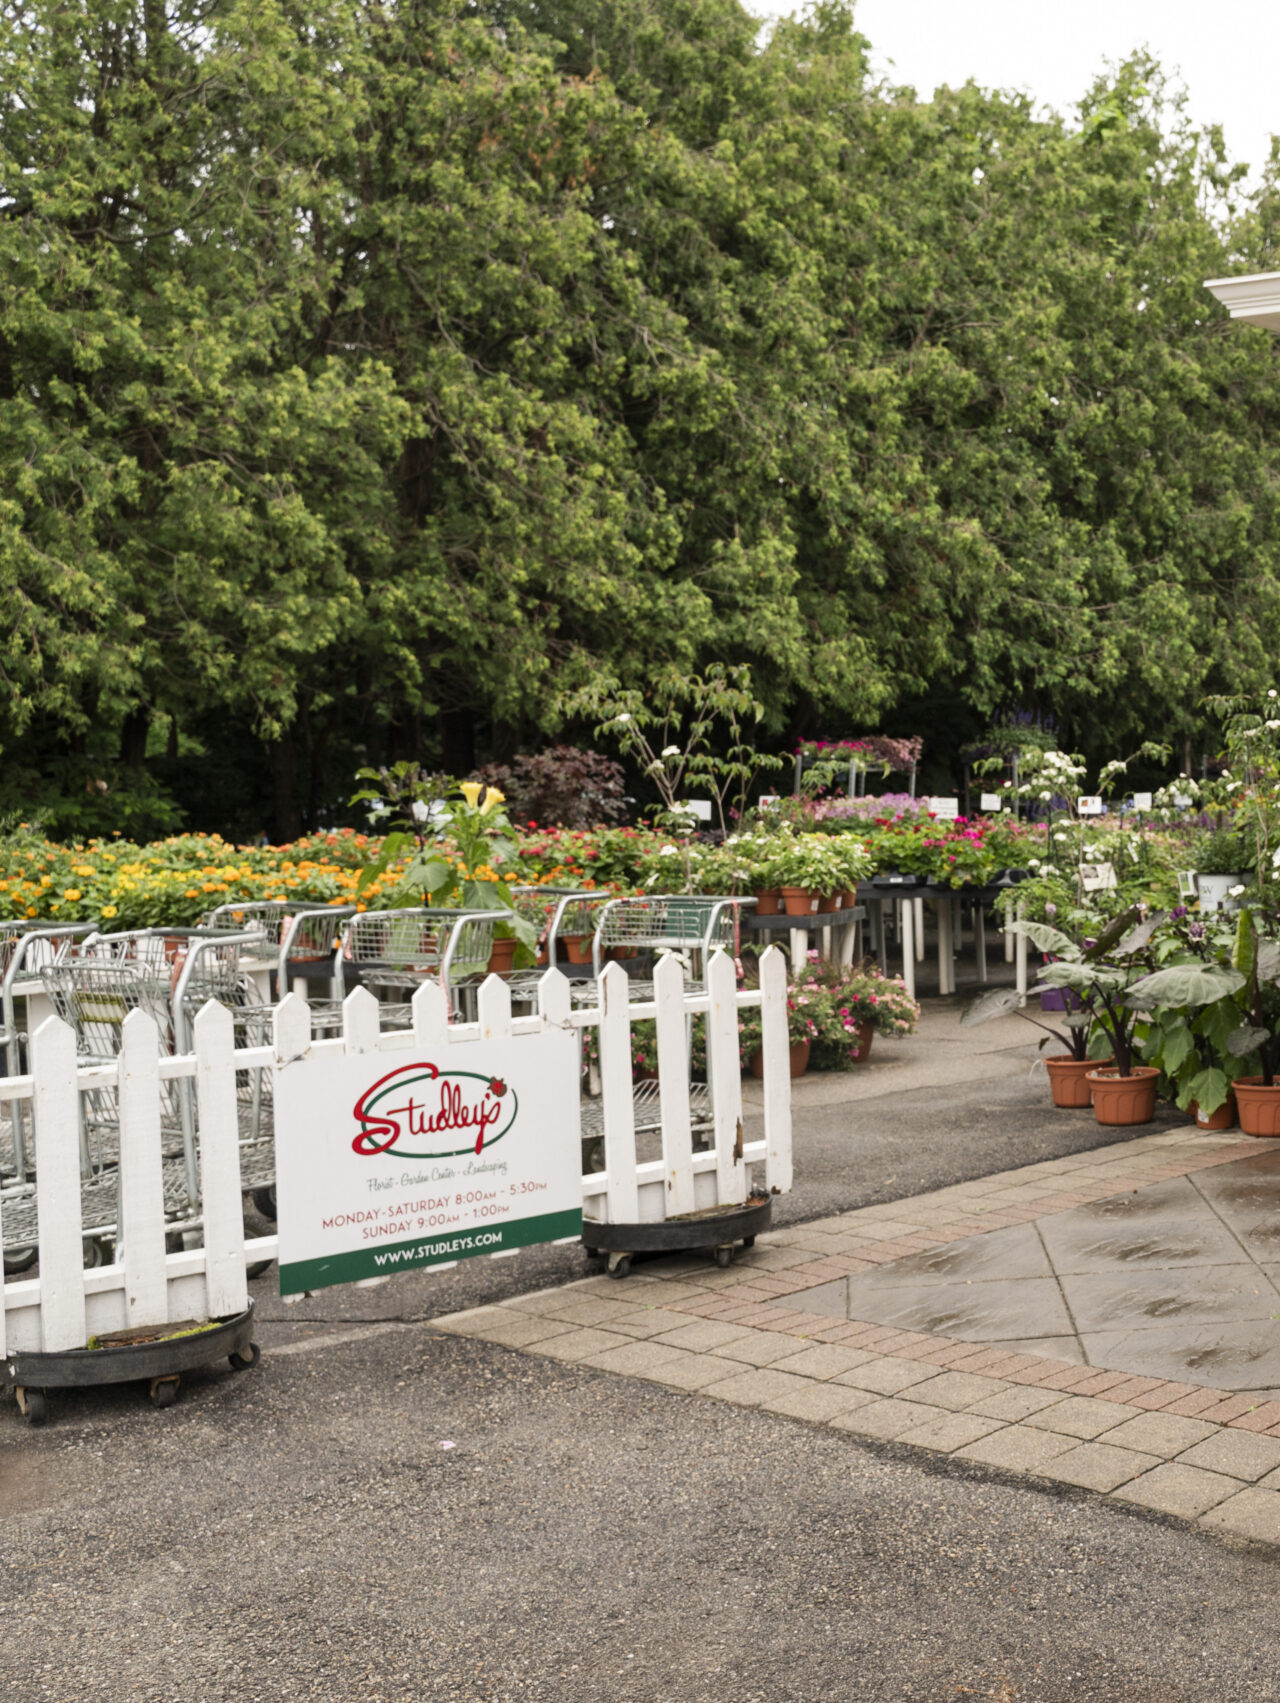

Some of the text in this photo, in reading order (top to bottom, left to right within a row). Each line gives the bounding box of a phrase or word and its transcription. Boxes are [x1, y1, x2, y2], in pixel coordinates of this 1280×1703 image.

[351, 1062, 501, 1155] Studley's
[400, 1171, 430, 1187] Garden
[322, 1196, 451, 1230] MONDAY-SATURDAY
[362, 1219, 413, 1240] SUNDAY
[374, 1231, 503, 1266] WWW.STUDLEYS.COM
